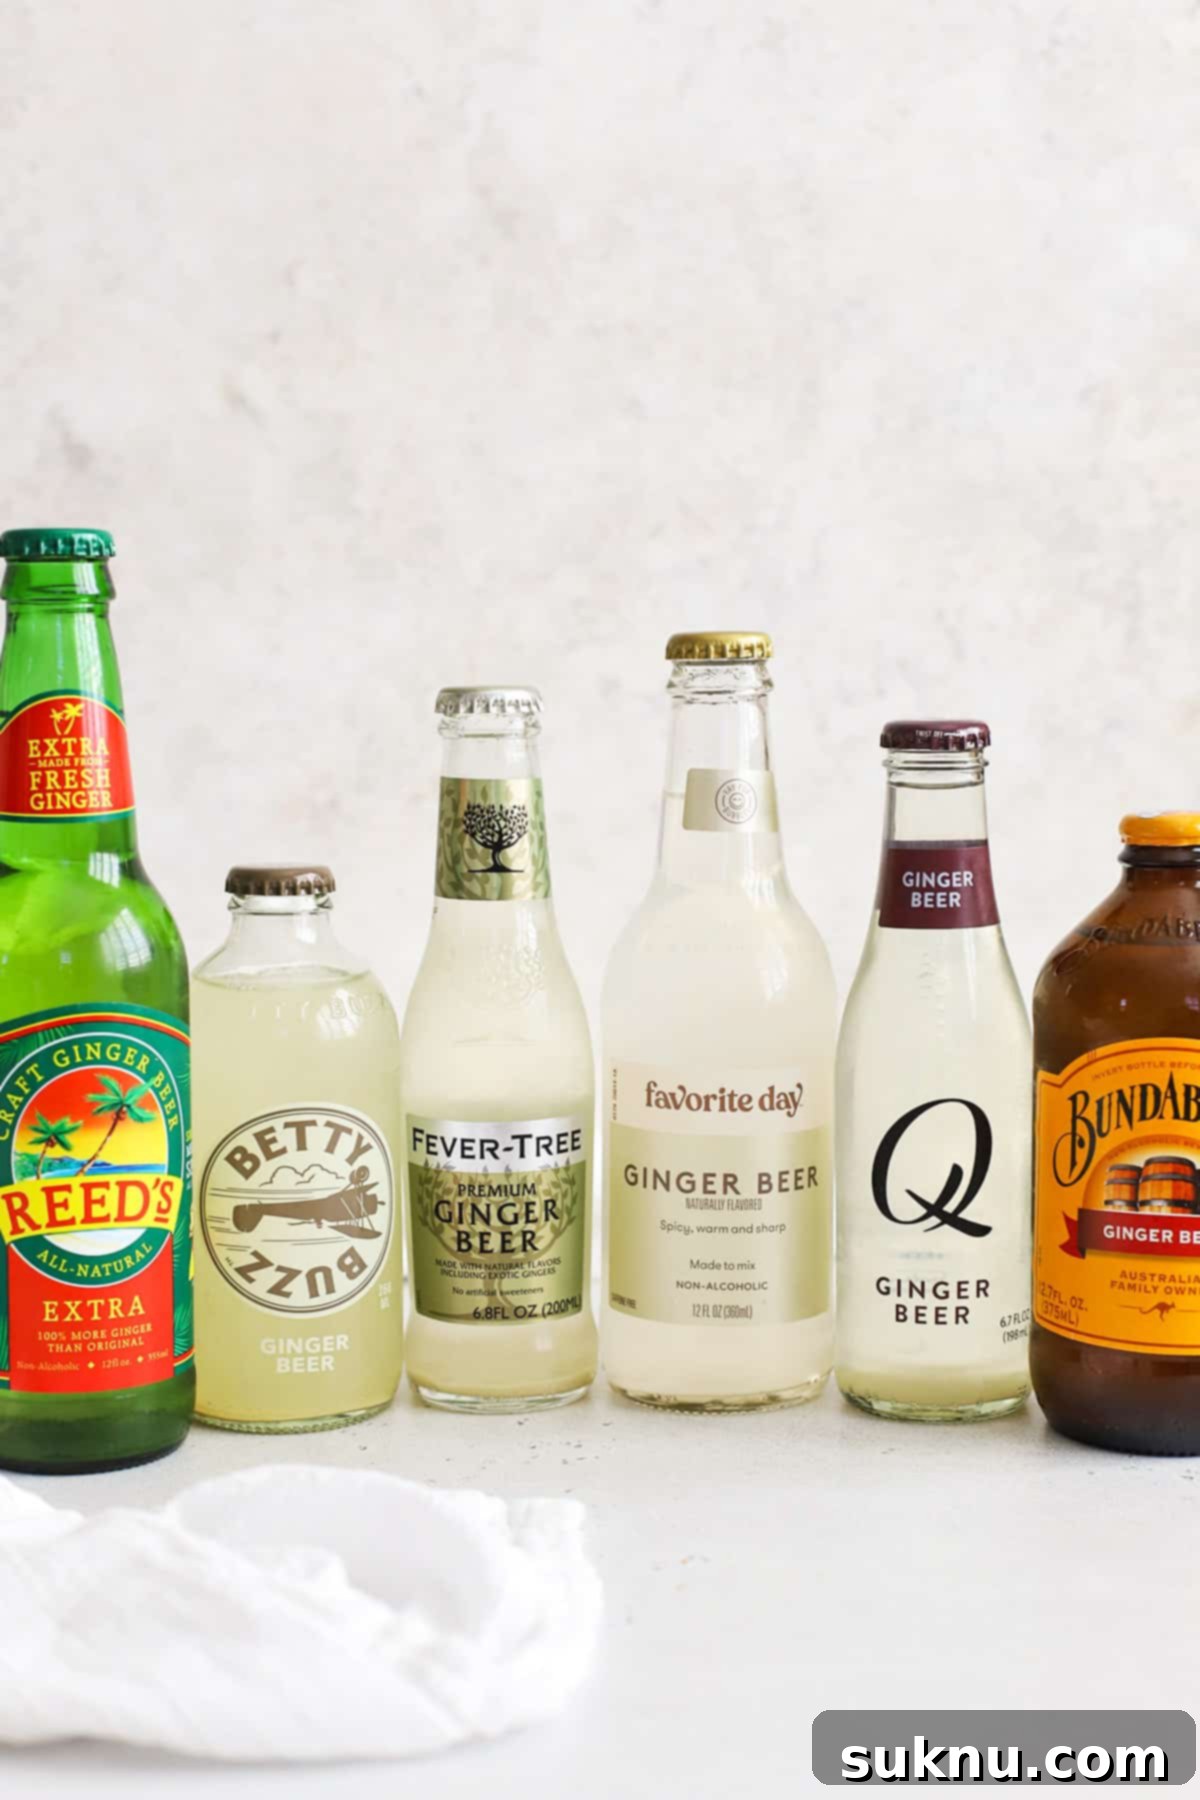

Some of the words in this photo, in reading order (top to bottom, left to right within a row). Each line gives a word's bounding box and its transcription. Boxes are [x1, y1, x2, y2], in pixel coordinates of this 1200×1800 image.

[28, 737, 110, 758] EXTRA
[38, 758, 71, 768] MADE
[29, 768, 111, 791] FRESH
[30, 791, 113, 811] GINGER
[902, 871, 974, 888] GINGER
[910, 891, 962, 909] BEER
[52, 1042, 150, 1074] GINGER
[152, 1070, 179, 1131] BEER
[645, 1080, 753, 1113] favorite
[758, 1082, 804, 1118] day
[224, 1119, 373, 1181] BETTY
[412, 1127, 582, 1160] FEVER-TREE
[871, 1098, 993, 1237] Q
[624, 1163, 741, 1195] GINGER
[757, 1165, 819, 1195] BEER
[457, 1183, 537, 1198] PREMIUM
[1, 1177, 174, 1235] REED'S
[434, 1199, 560, 1226] GINGER
[685, 1198, 725, 1211] NATURALLY
[726, 1198, 763, 1212] FLAVORED
[660, 1219, 694, 1236] Spicy,
[696, 1225, 729, 1234] warm
[730, 1224, 754, 1234] and
[755, 1223, 787, 1235] sharp
[1103, 1225, 1173, 1243] GINGER
[456, 1230, 540, 1254] BEER
[37, 1242, 153, 1278] ALL-NATURAL
[436, 1257, 457, 1269] MADE
[460, 1261, 481, 1270] WITH
[484, 1261, 524, 1271] NATURAL
[527, 1257, 561, 1269] FLAVORS
[689, 1259, 722, 1271] Made
[723, 1261, 735, 1271] to
[736, 1260, 756, 1271] mix
[234, 1246, 368, 1299] BUZZ
[441, 1268, 487, 1280] INCLUDING
[488, 1270, 519, 1280] EXOTIC
[521, 1267, 556, 1279] GINGERS
[452, 1286, 464, 1295] No
[465, 1286, 497, 1296] artificial
[499, 1287, 544, 1296] sweeteners
[675, 1280, 769, 1292] NON-ALCOHOLIC
[875, 1276, 990, 1300] GINGER
[1110, 1280, 1159, 1294] FAMILY
[1163, 1285, 1200, 1296] OWN
[42, 1295, 146, 1323] EXTRA
[472, 1306, 509, 1320] 6.8FL
[513, 1304, 537, 1319] OZ
[692, 1303, 701, 1318] 12
[702, 1304, 710, 1318] FL
[712, 1304, 722, 1319] OZ
[895, 1303, 970, 1325] BEER
[38, 1331, 66, 1341] 100%
[71, 1329, 107, 1341] MORE
[111, 1323, 152, 1338] GINGER
[48, 1343, 82, 1353] THAN
[87, 1336, 144, 1352] ORIGINAL
[260, 1333, 350, 1355] GINGER
[276, 1355, 335, 1373] BEER
